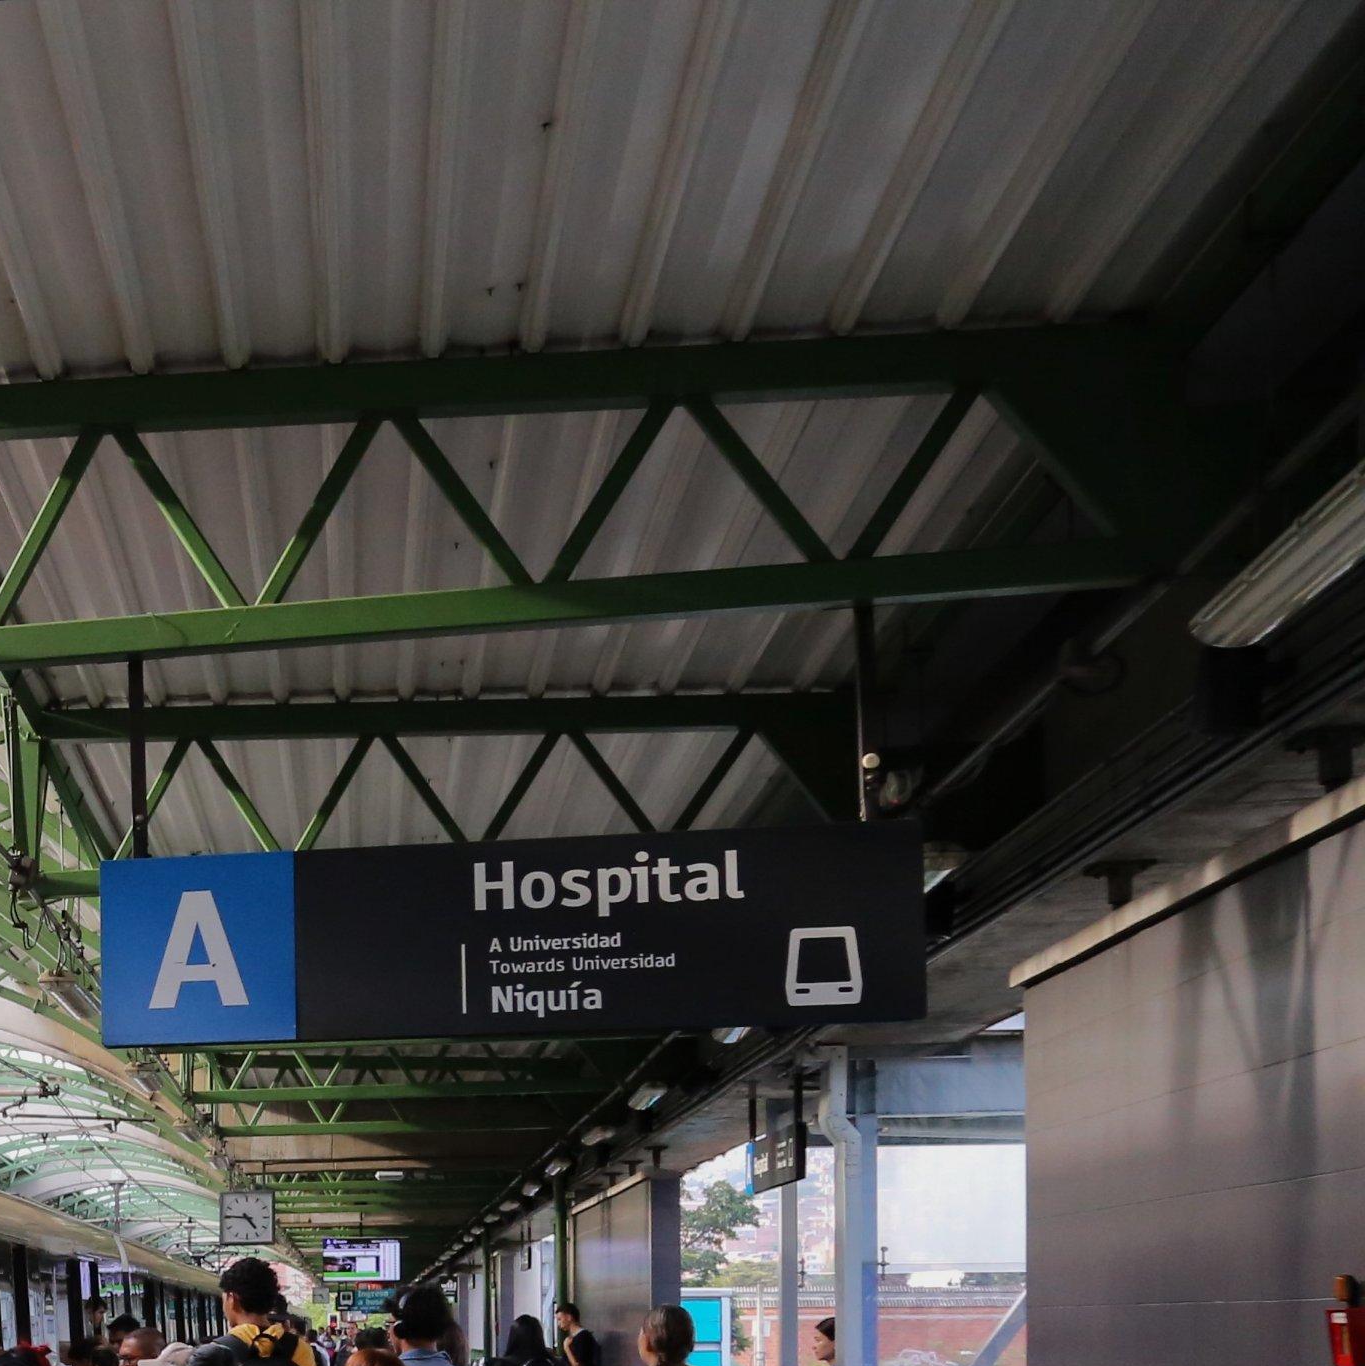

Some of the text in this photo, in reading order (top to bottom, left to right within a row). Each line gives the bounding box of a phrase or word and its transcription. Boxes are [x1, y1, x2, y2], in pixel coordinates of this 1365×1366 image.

[474, 850, 745, 917] Hospital
[149, 890, 249, 1009] A
[489, 932, 622, 953] A Universidad
[489, 953, 676, 974] Towards Universidad
[491, 981, 603, 1018] Niquía
